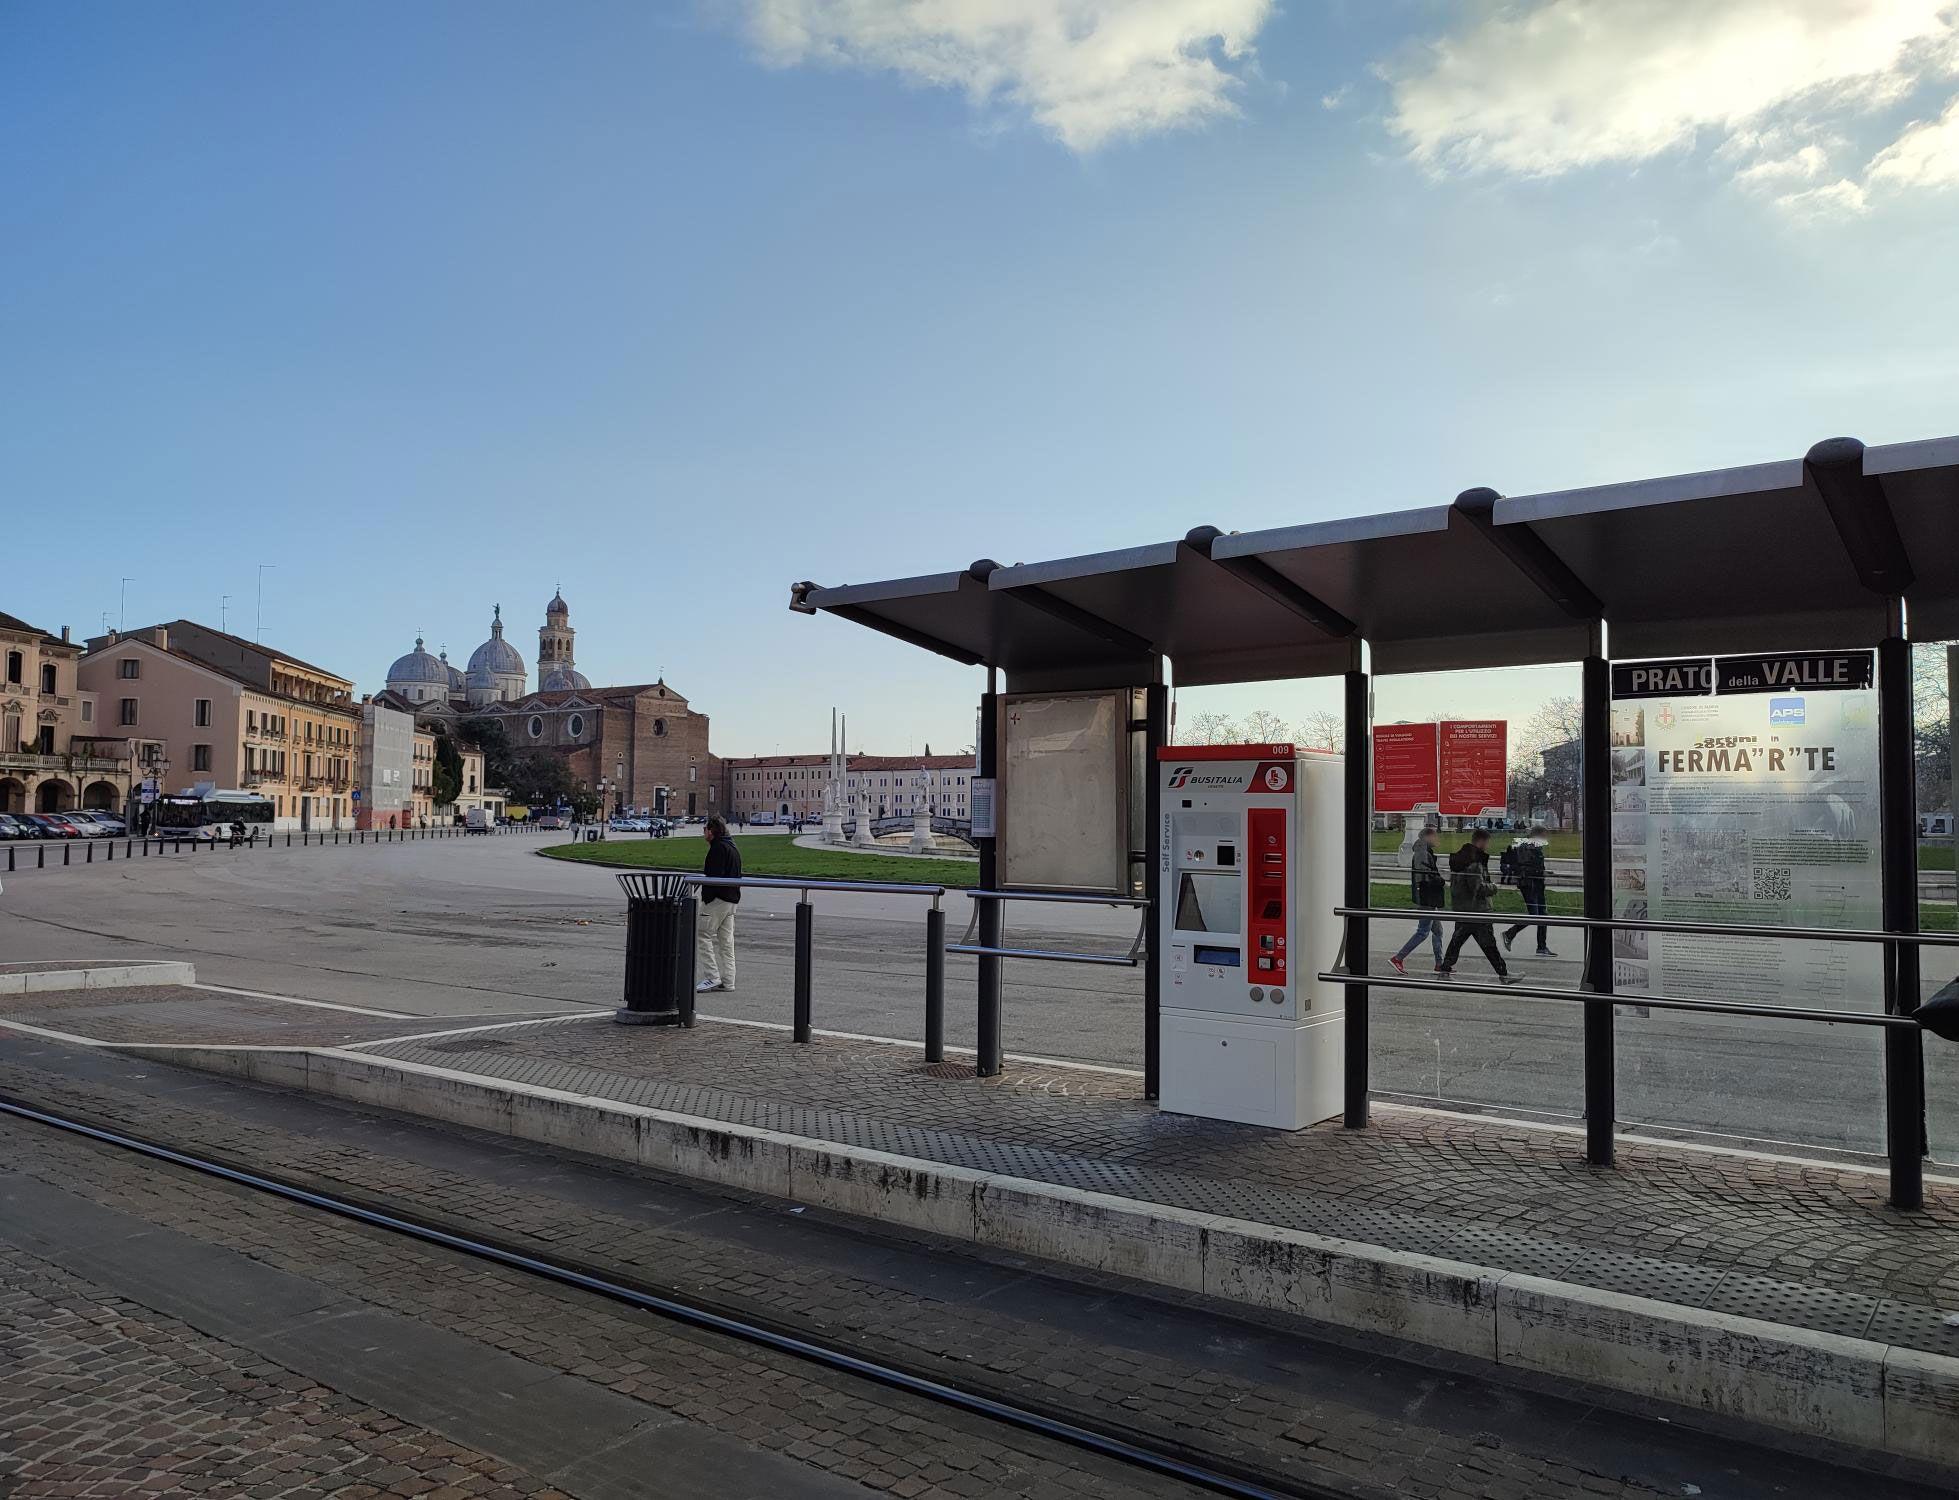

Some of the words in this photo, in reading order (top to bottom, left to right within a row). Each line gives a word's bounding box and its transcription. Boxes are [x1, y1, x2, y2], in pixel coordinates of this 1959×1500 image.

[1632, 666, 1720, 691] PRATO
[1728, 675, 1759, 687] della
[1762, 659, 1849, 684] VALLE
[1770, 709, 1805, 718] APS
[1272, 745, 1289, 755] 009
[1190, 776, 1243, 784] BUSITALIA
[1162, 812, 1170, 851] Service
[1162, 853, 1170, 873] Self
